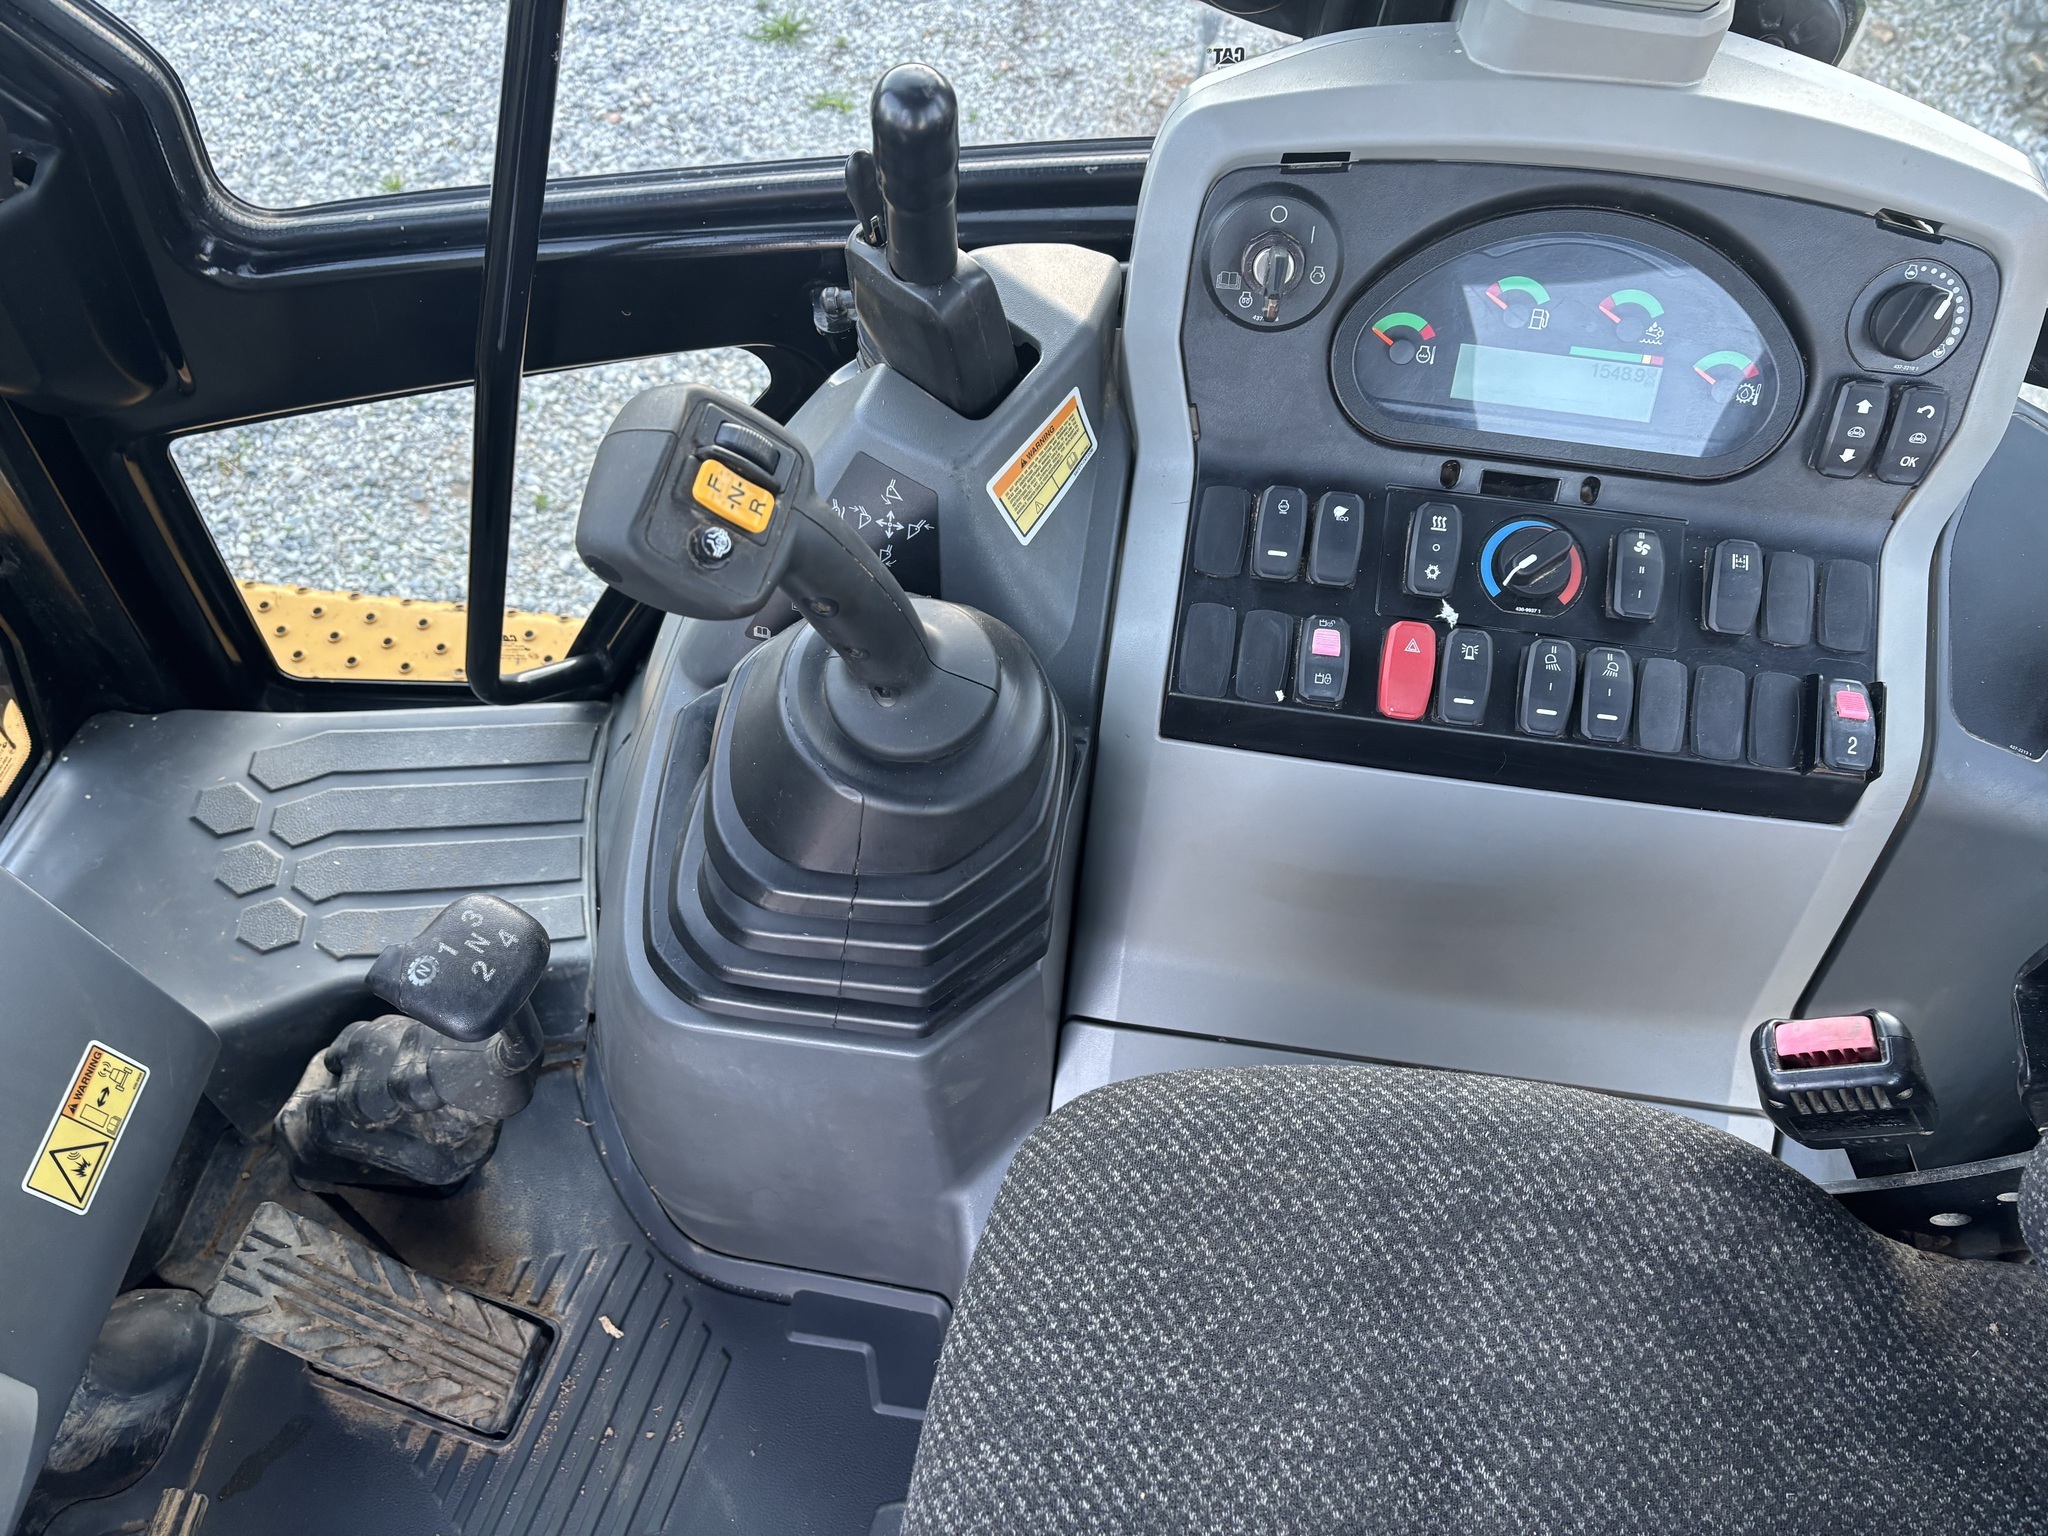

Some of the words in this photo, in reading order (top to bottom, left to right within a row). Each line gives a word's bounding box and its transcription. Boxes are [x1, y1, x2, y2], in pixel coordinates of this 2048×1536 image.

[1591, 363, 1646, 383] 1548.9
[1025, 424, 1055, 461] WARNING
[1900, 455, 1920, 468] OK
[706, 473, 722, 493] F
[748, 498, 766, 516] R
[1845, 684, 1851, 692] 1
[1847, 736, 1858, 755] 2
[461, 909, 484, 928] 3
[463, 932, 491, 954] N
[498, 928, 520, 948] 4
[438, 941, 459, 956] 1
[471, 960, 497, 982] 2
[73, 1051, 103, 1101] WARNING
